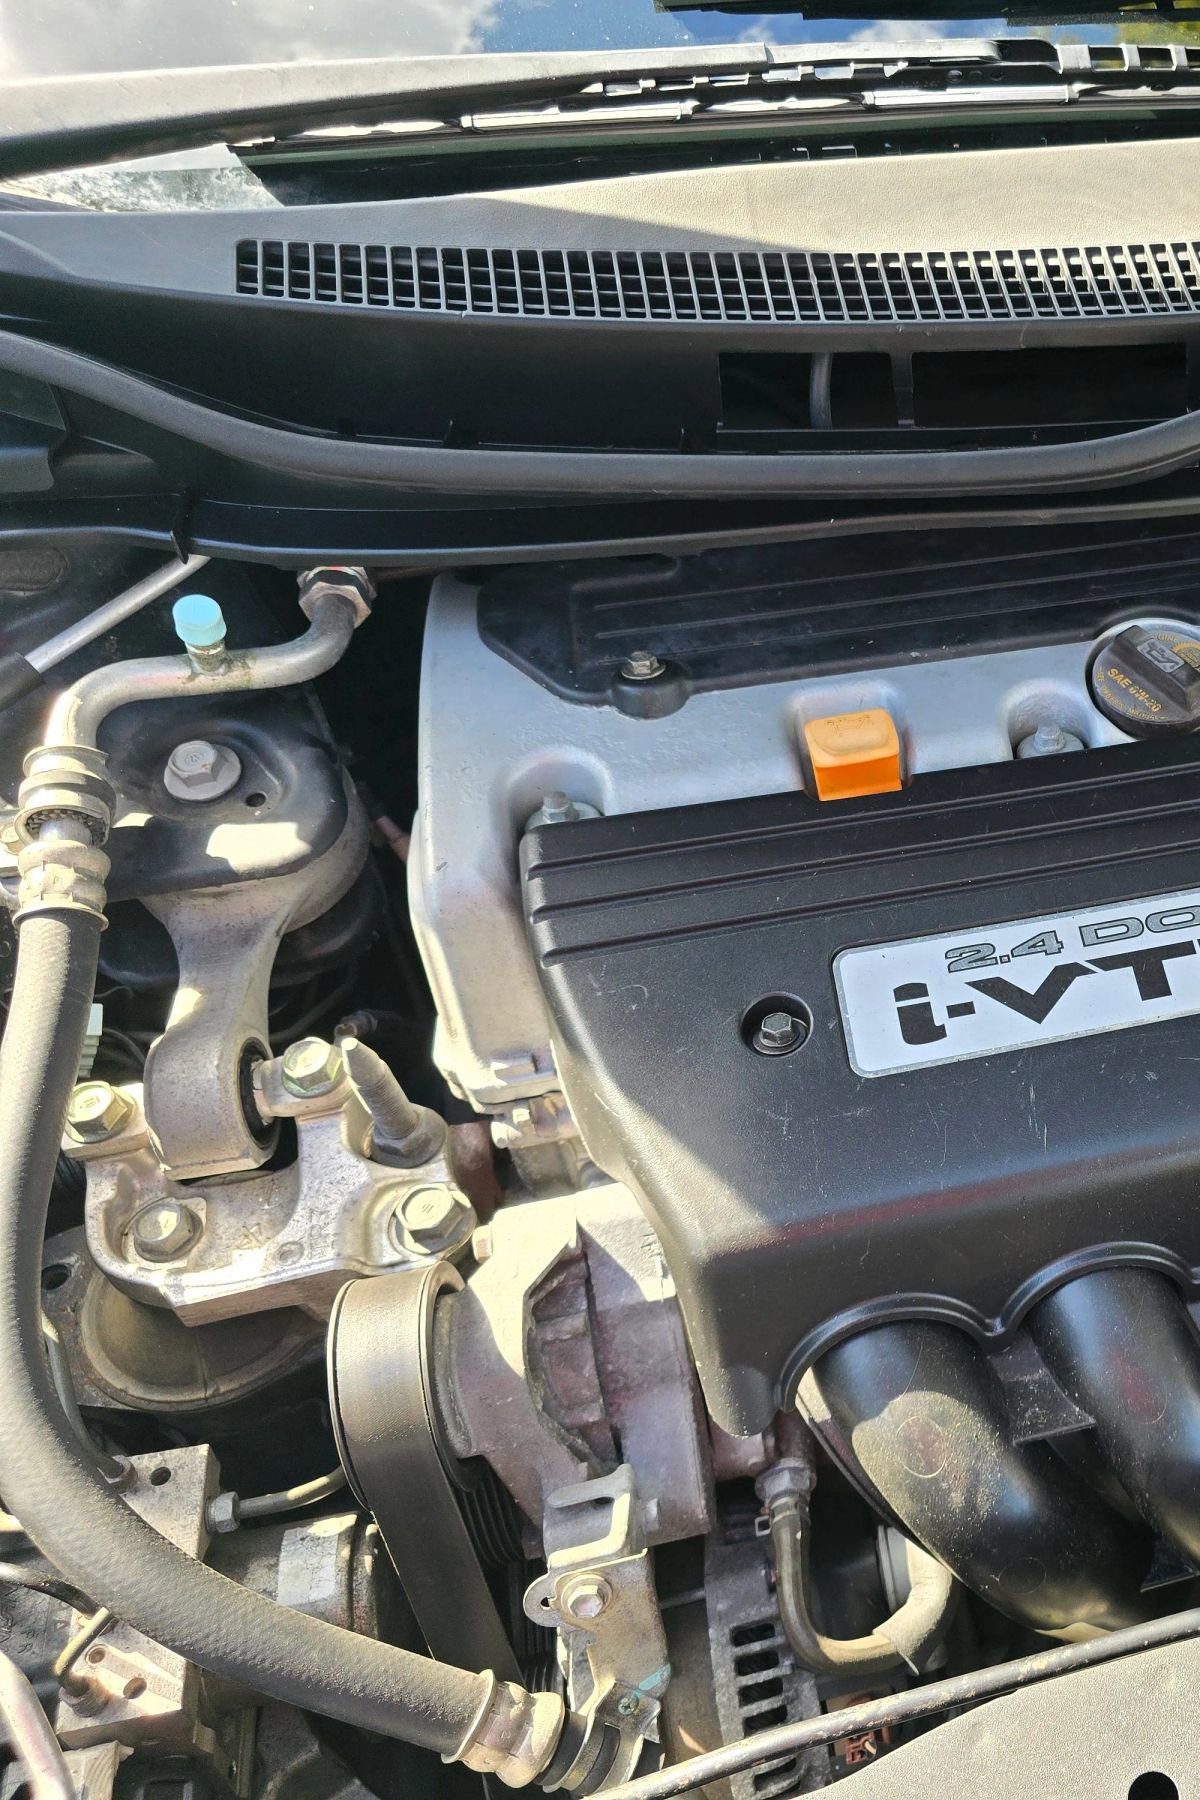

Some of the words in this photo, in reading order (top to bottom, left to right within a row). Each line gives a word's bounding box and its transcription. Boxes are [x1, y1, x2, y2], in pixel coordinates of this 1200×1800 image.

[1107, 667, 1132, 688] SAE
[1128, 685, 1163, 713] 0W-20
[943, 930, 1065, 974] 2.4
